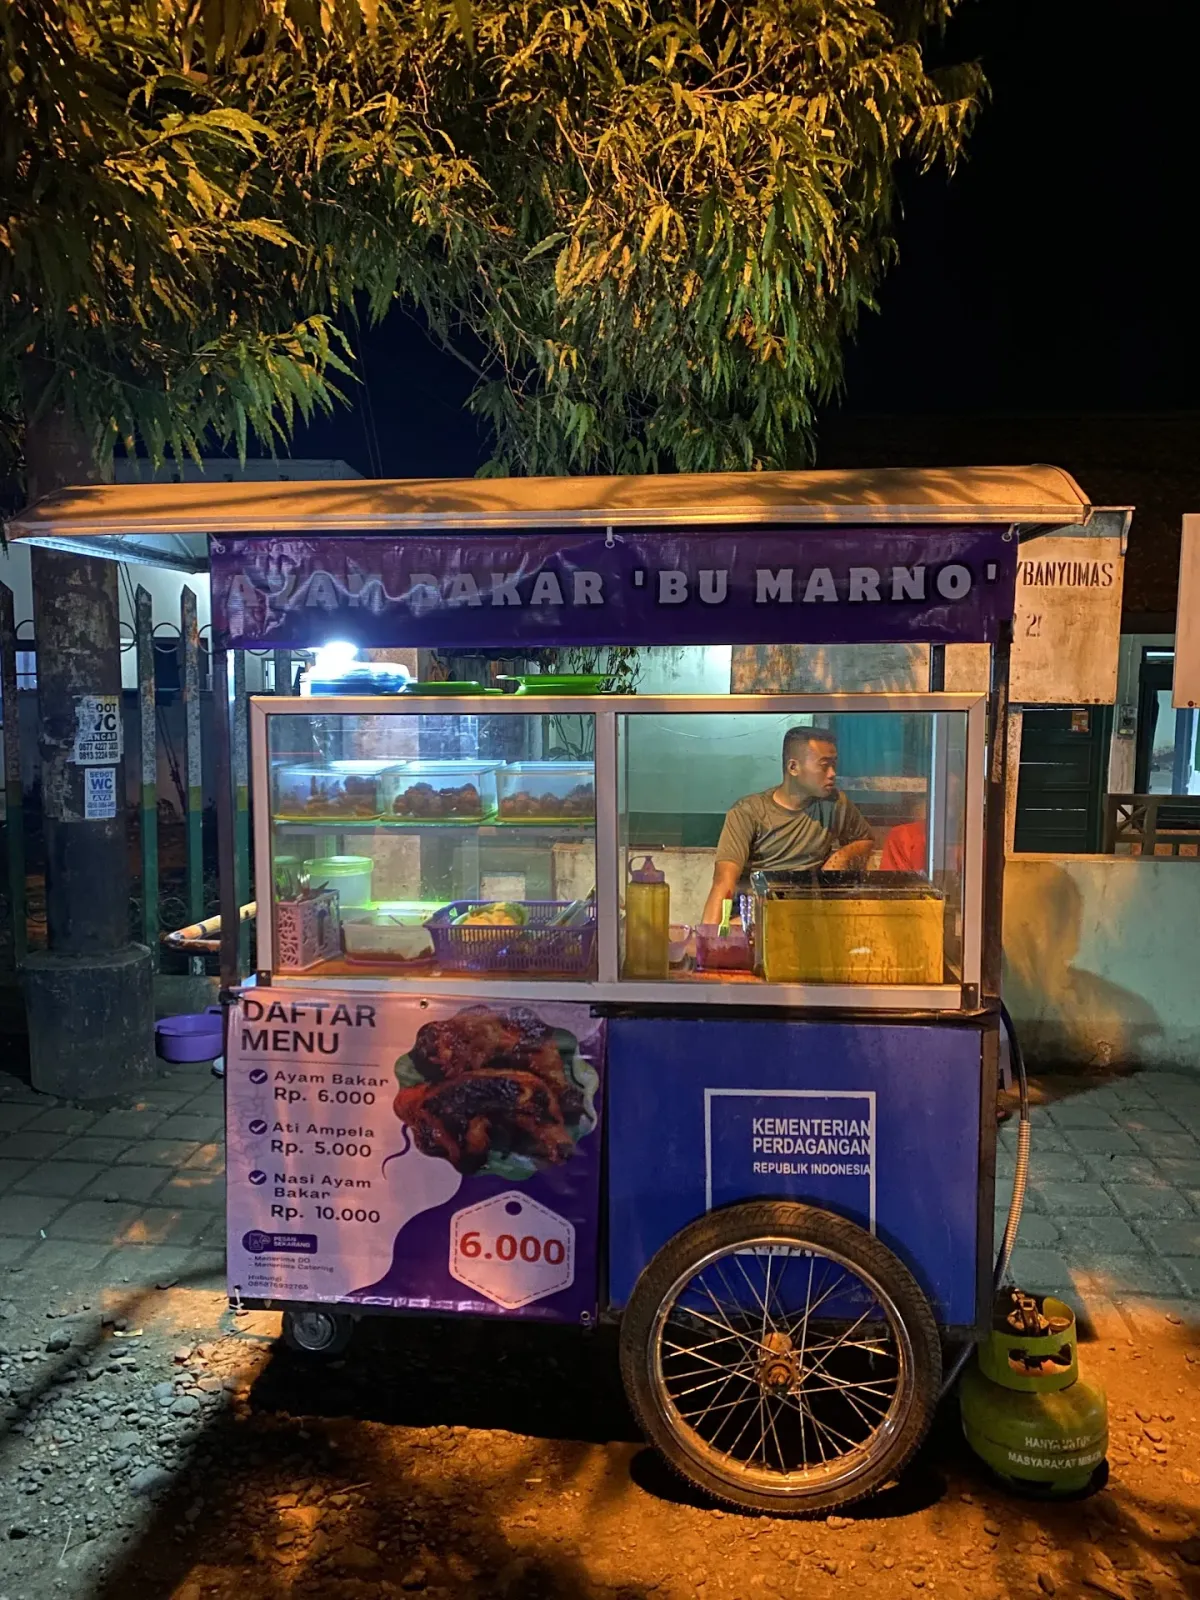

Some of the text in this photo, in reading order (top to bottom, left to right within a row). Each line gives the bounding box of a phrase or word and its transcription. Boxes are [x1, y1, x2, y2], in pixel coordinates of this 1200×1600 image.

[410, 570, 604, 605] BAKAR
[90, 778, 113, 790] WC
[242, 1000, 376, 1028] DAFTAR
[241, 1029, 339, 1054] MENU
[274, 1070, 389, 1087] Ayam Bakar
[273, 1087, 376, 1106] Rp. 6.000
[272, 1122, 375, 1138] Ati Ampela
[752, 1117, 871, 1137] KEMENTERIAN
[270, 1139, 372, 1158] Rp. 5.000
[752, 1137, 871, 1155] PERDAGANGAN
[753, 1162, 871, 1175] REPUBLIK INDONESIA
[273, 1173, 372, 1189] Nasi Ayam
[273, 1187, 331, 1200] Bakar
[271, 1204, 381, 1223] Rp. 10.000
[273, 1241, 311, 1249] SEKARANG
[459, 1231, 566, 1266] 6.000
[254, 1255, 296, 1263] Menerima
[254, 1262, 334, 1273] Menerima Catering
[1025, 1436, 1059, 1449] HANYA
[1008, 1451, 1076, 1470] MASYARAKAT
